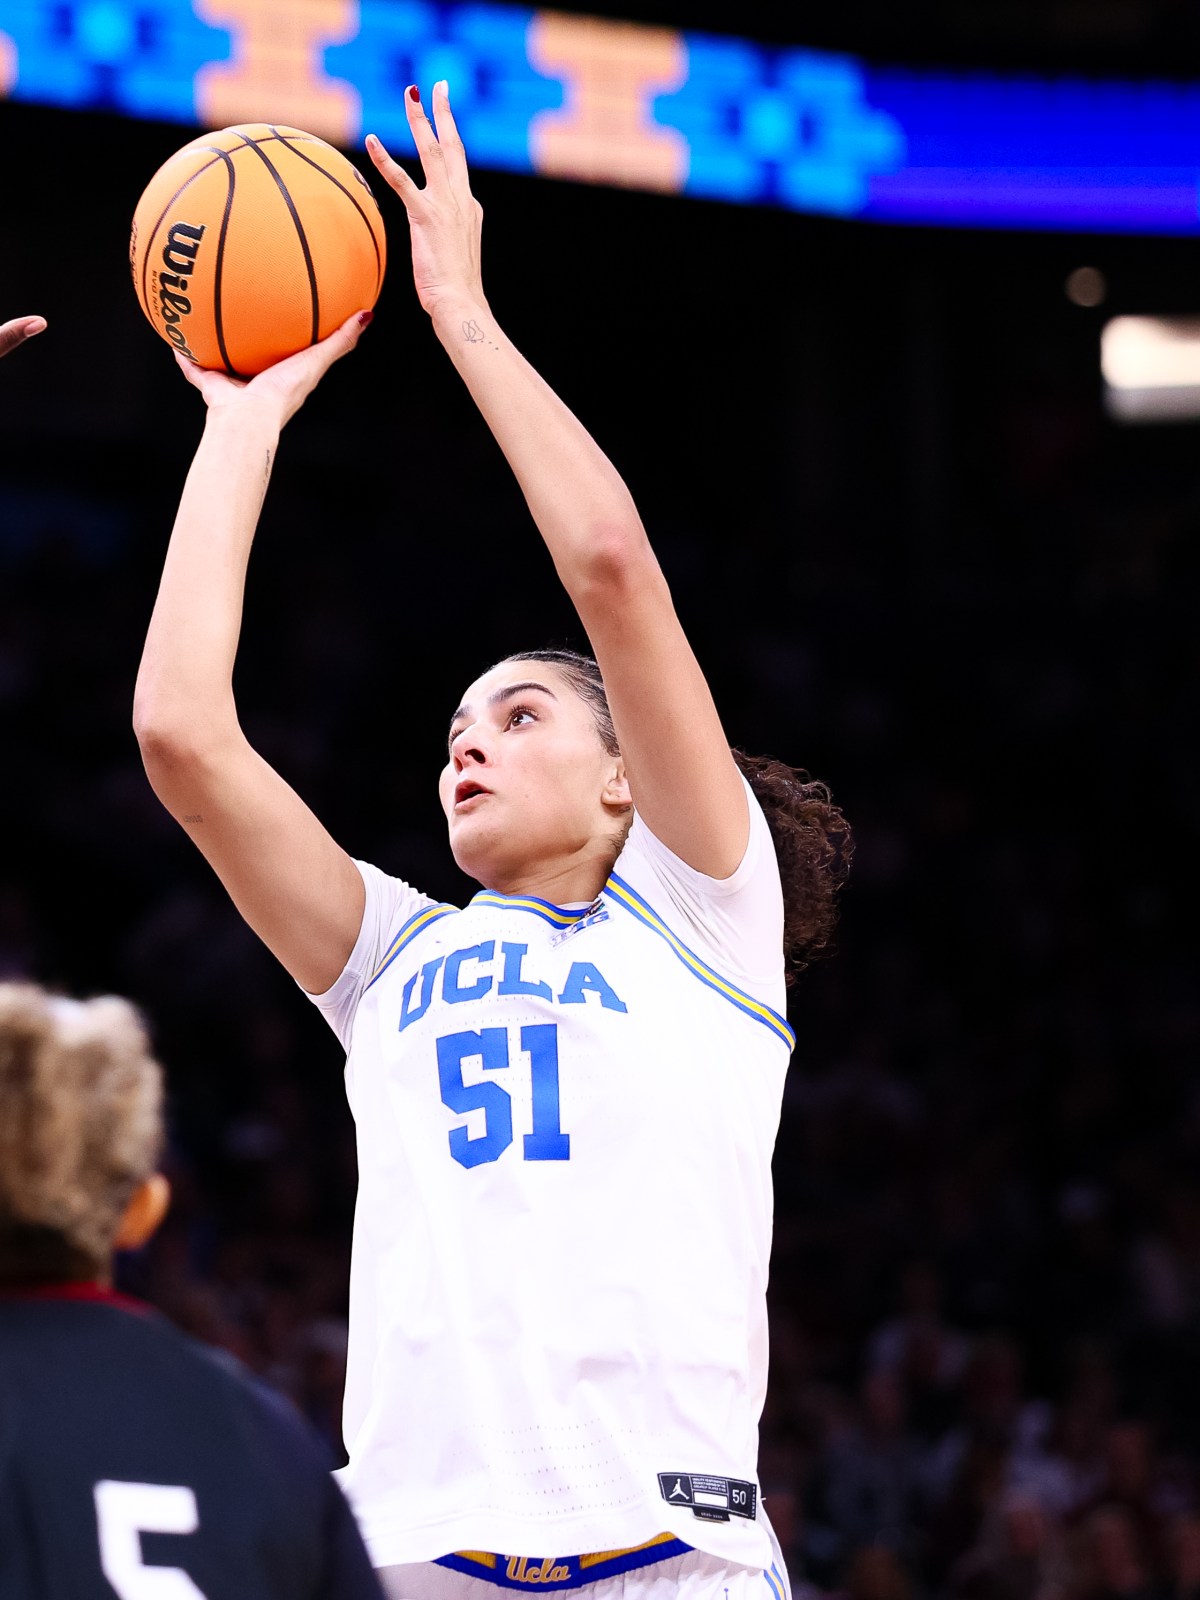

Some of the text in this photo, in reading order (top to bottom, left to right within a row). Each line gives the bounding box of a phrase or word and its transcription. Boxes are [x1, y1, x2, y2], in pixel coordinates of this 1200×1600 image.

[159, 220, 208, 363] Wilson
[398, 939, 629, 1032] UCLA
[435, 1023, 571, 1170] 51
[732, 1489, 747, 1506] 50
[504, 1554, 572, 1584] Ucla
